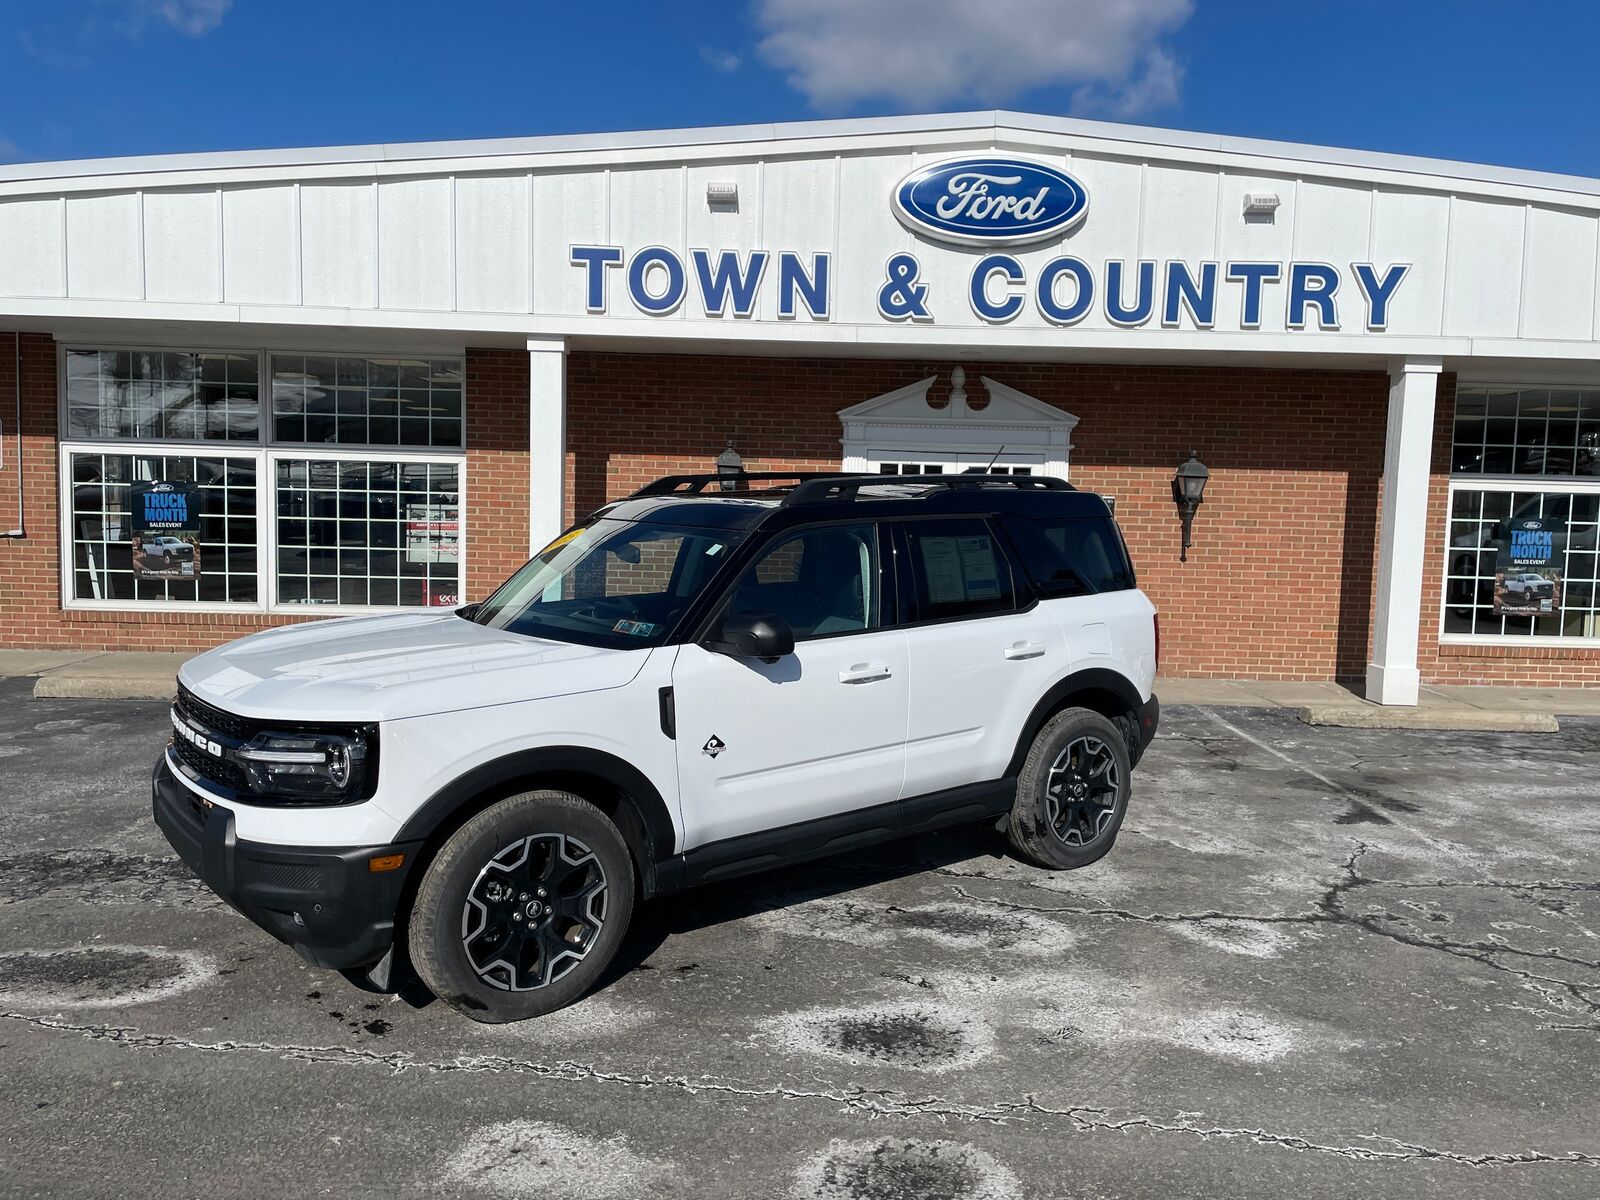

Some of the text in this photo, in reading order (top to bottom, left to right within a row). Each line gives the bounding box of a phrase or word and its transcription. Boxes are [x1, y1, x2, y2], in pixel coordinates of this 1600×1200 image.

[935, 172, 1051, 221] Ford
[569, 244, 1413, 331] TOWN & COUNTRY
[143, 493, 187, 508] TRUCK
[144, 508, 188, 522] MONTH
[1511, 530, 1552, 546] TRUCK
[1510, 545, 1552, 559] MONTH
